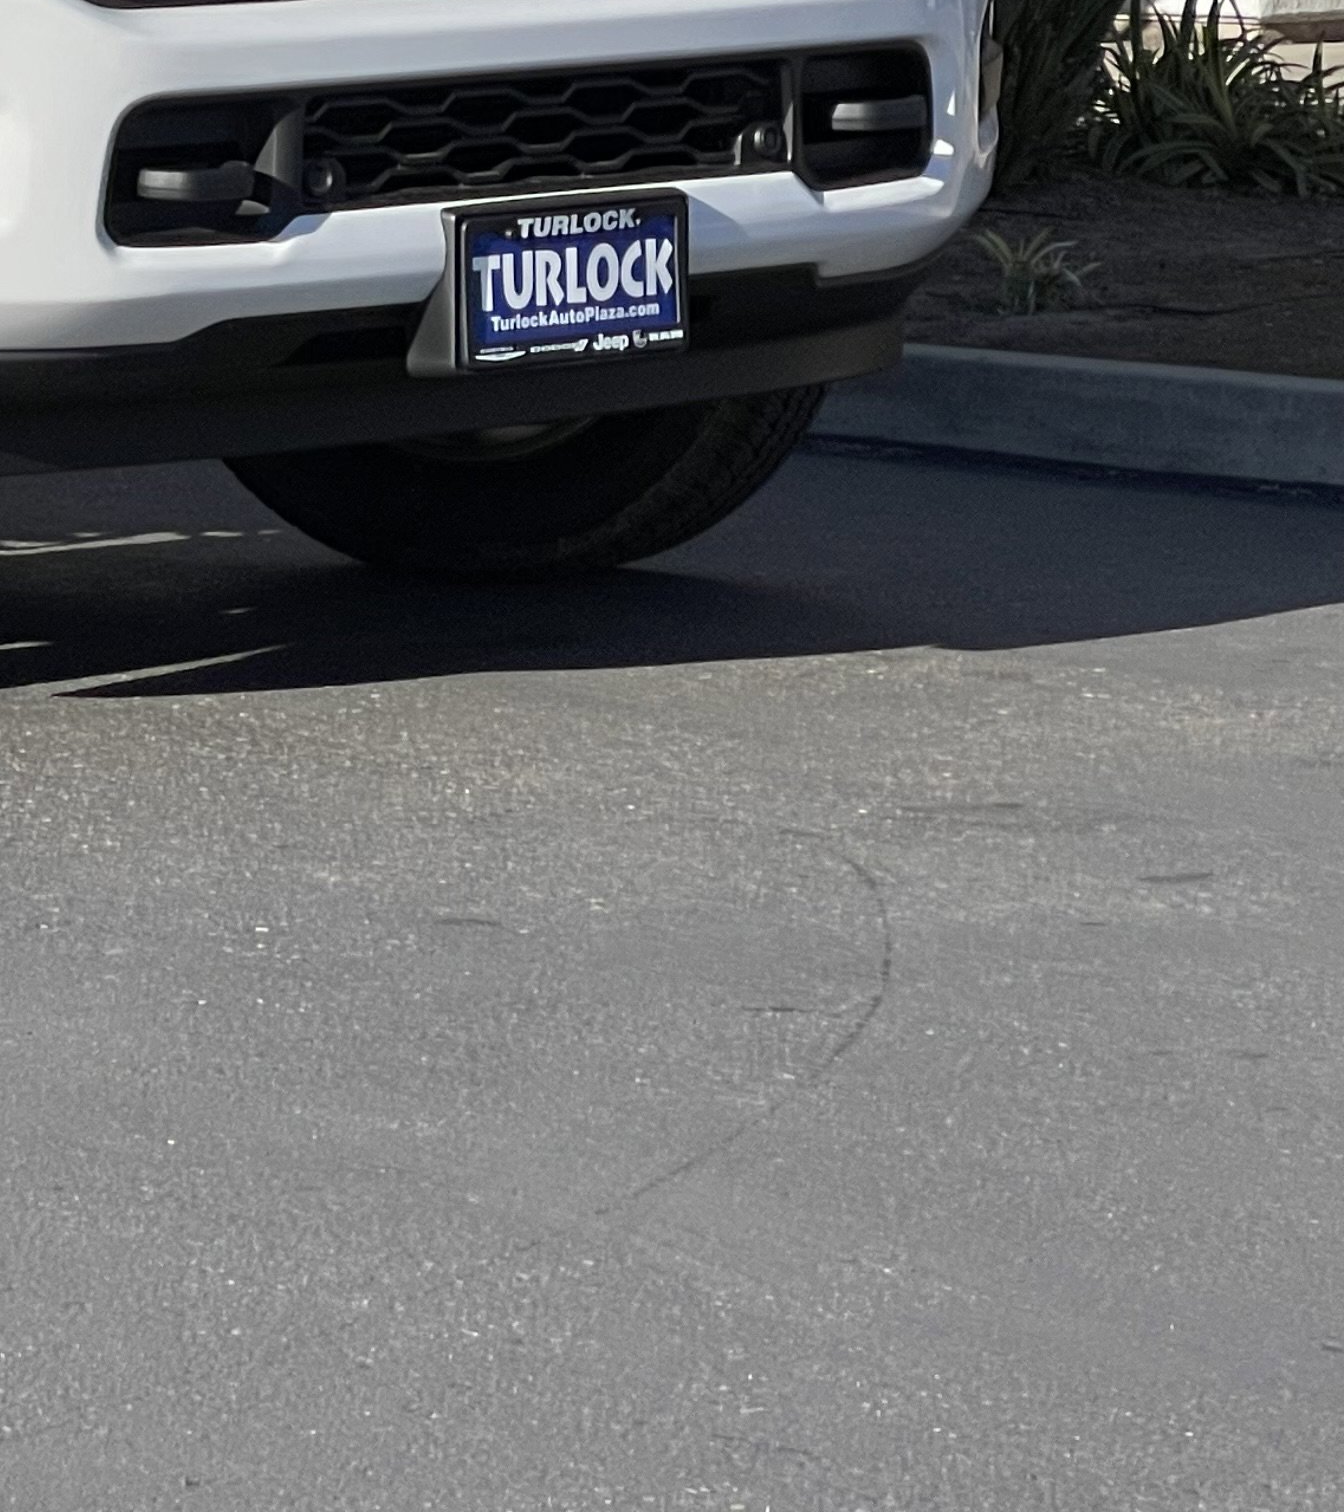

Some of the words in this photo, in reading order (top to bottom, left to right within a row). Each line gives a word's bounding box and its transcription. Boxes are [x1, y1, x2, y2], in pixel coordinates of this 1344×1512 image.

[517, 207, 638, 239] TURLOCK
[471, 238, 674, 313] TURLOCK
[490, 303, 660, 332] TurlockAutoPlaza.com
[592, 333, 629, 351] Jeep
